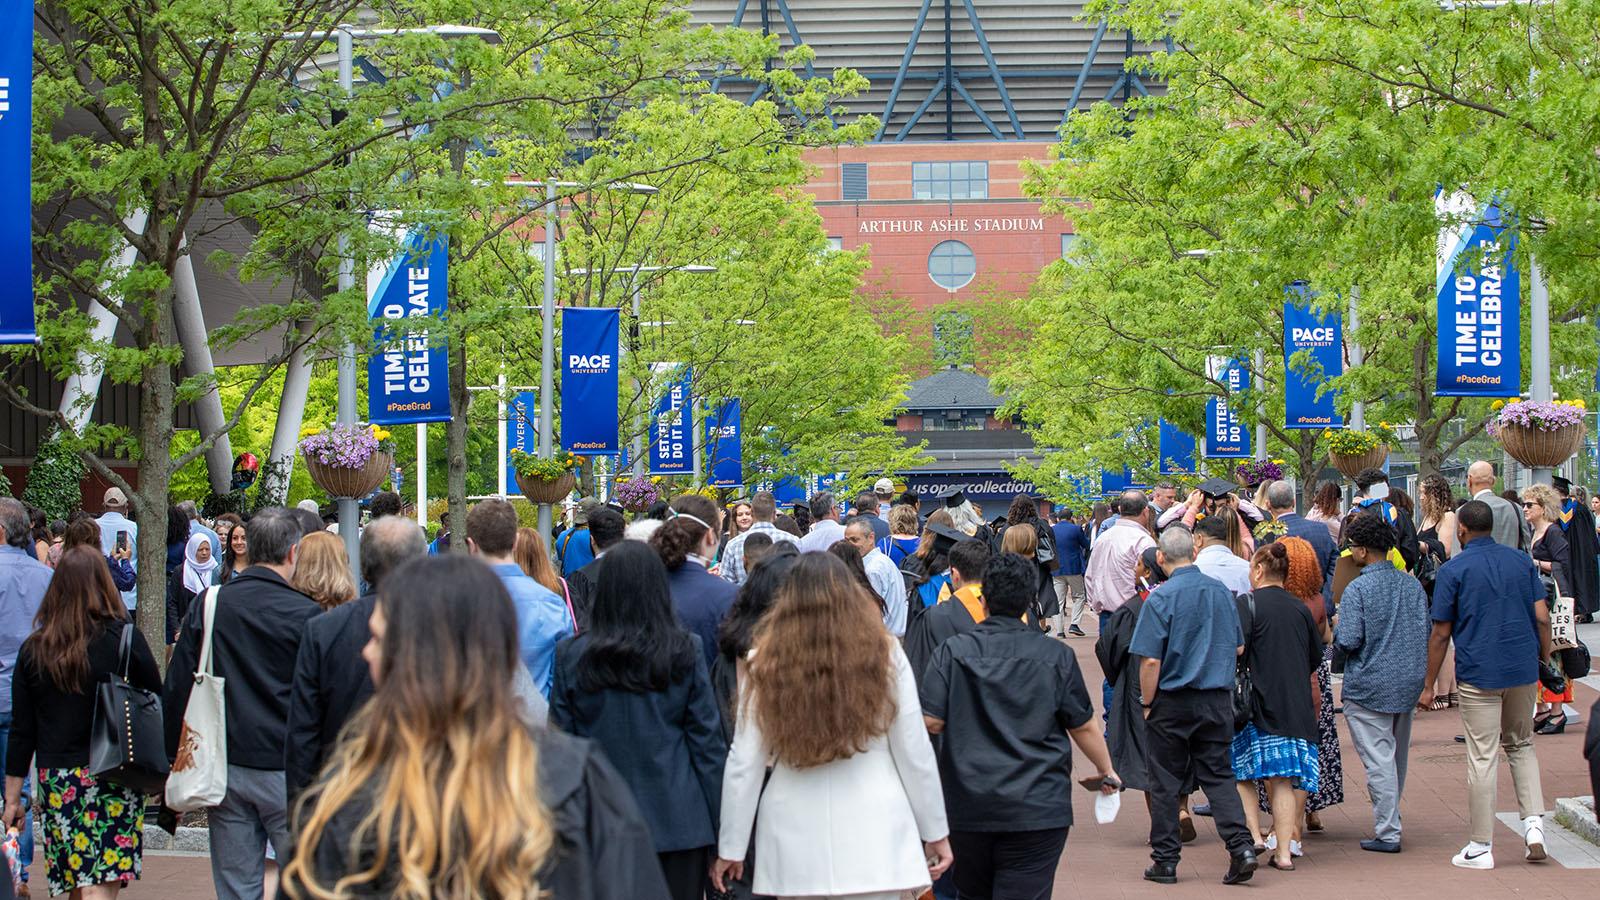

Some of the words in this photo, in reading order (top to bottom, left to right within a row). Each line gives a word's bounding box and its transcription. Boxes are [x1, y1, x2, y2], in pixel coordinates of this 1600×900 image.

[859, 220, 924, 233] ARTHUR
[929, 219, 969, 232] ASHE
[974, 218, 1044, 232] STADIUM
[1456, 276, 1477, 305] TO
[408, 267, 430, 393] CELERATE
[1292, 328, 1334, 341] PACE
[1456, 311, 1477, 367] TIME
[569, 355, 611, 368] PACE
[1456, 374, 1501, 384] #PaceGrad
[387, 401, 431, 412] #PaceGrad
[1298, 416, 1331, 424] #PaceGrad
[672, 429, 683, 440] IT
[1230, 426, 1241, 442] DO
[672, 442, 683, 459] DO
[967, 480, 1033, 493] collection
